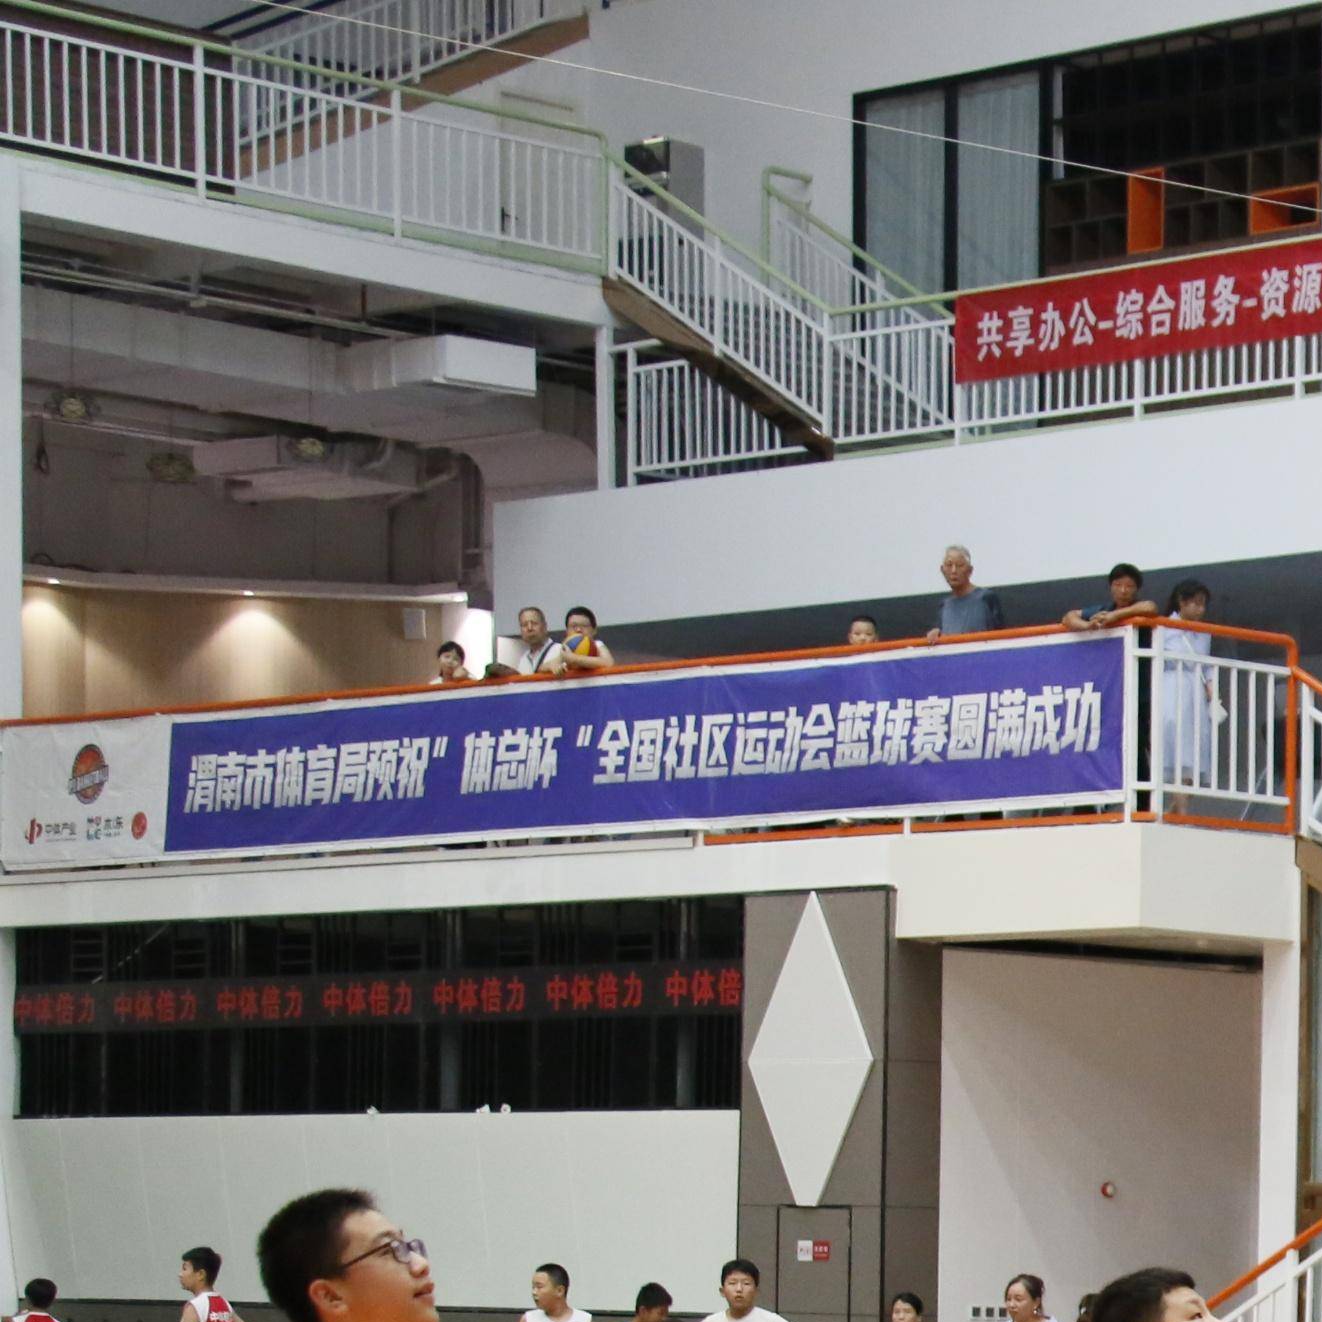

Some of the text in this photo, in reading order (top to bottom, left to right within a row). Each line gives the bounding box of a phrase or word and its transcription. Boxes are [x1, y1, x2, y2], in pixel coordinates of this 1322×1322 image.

[14, 991, 96, 1024] 中体倍力
[113, 986, 198, 1022] 中体倍力
[216, 983, 304, 1020] 中体倍力
[322, 980, 413, 1017] 中体倍力
[432, 976, 526, 1015] 中体倍力
[545, 972, 645, 1012] 中体倍力
